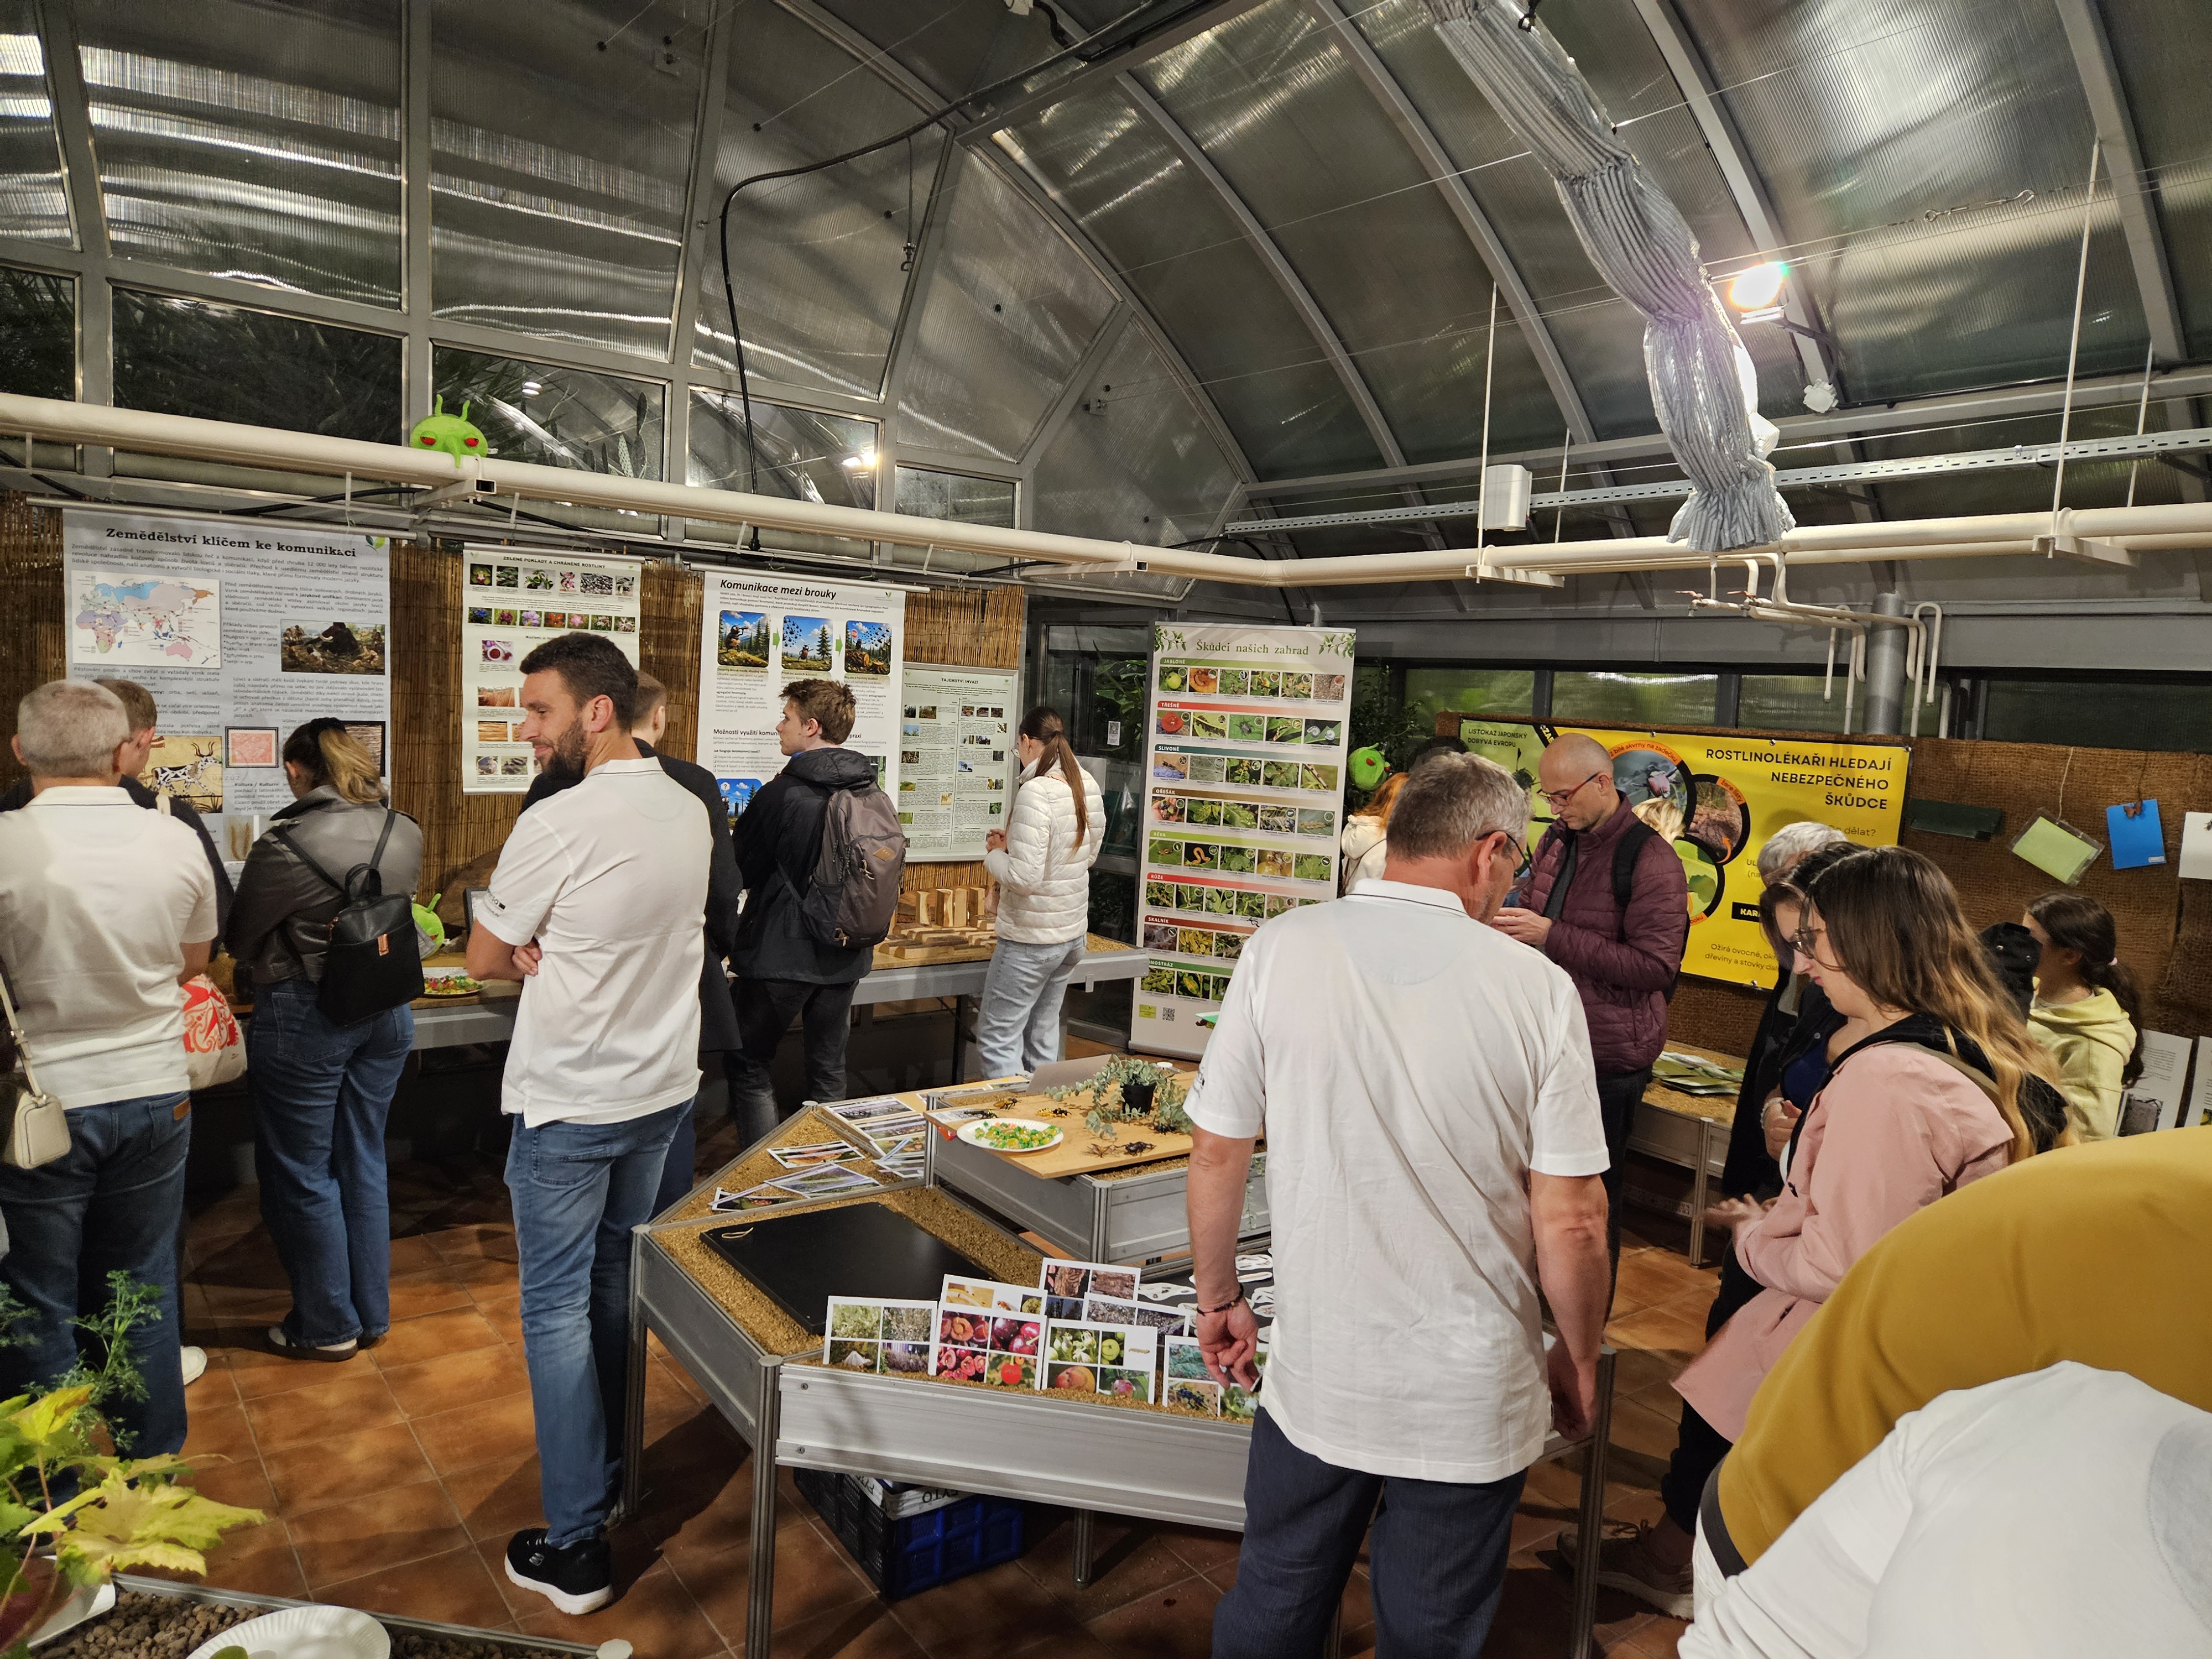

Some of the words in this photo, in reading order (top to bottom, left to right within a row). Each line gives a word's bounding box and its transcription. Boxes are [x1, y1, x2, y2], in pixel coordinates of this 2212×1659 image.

[106, 528, 197, 544] Zemědělství
[202, 535, 250, 548] klíčem
[255, 539, 271, 550] ke
[276, 541, 356, 557] komunikaci
[720, 580, 779, 593] Komunikace
[780, 586, 802, 596] mezi
[805, 587, 836, 600] brouky
[1196, 639, 1230, 652] Škůdci
[1235, 643, 1269, 654] našich
[1274, 645, 1309, 655] zahrad
[1498, 730, 1527, 739] JAPONSKÝ
[1655, 745, 1678, 762] zadečku
[1705, 749, 1825, 767] ROSTLINOLÉKAŘI
[1829, 757, 1892, 771] HLEDAJÍ
[1771, 771, 1889, 790] NEBEZPEČNÉHO
[1825, 791, 1888, 809] ŠKŮDCE
[1844, 827, 1876, 837] dělat?
[1740, 907, 1760, 917] KAR
[1710, 943, 1730, 952] Ožírá
[1733, 948, 1762, 959] ovocné,
[1705, 953, 1733, 964] dřeviny
[1740, 959, 1765, 971] stovky
